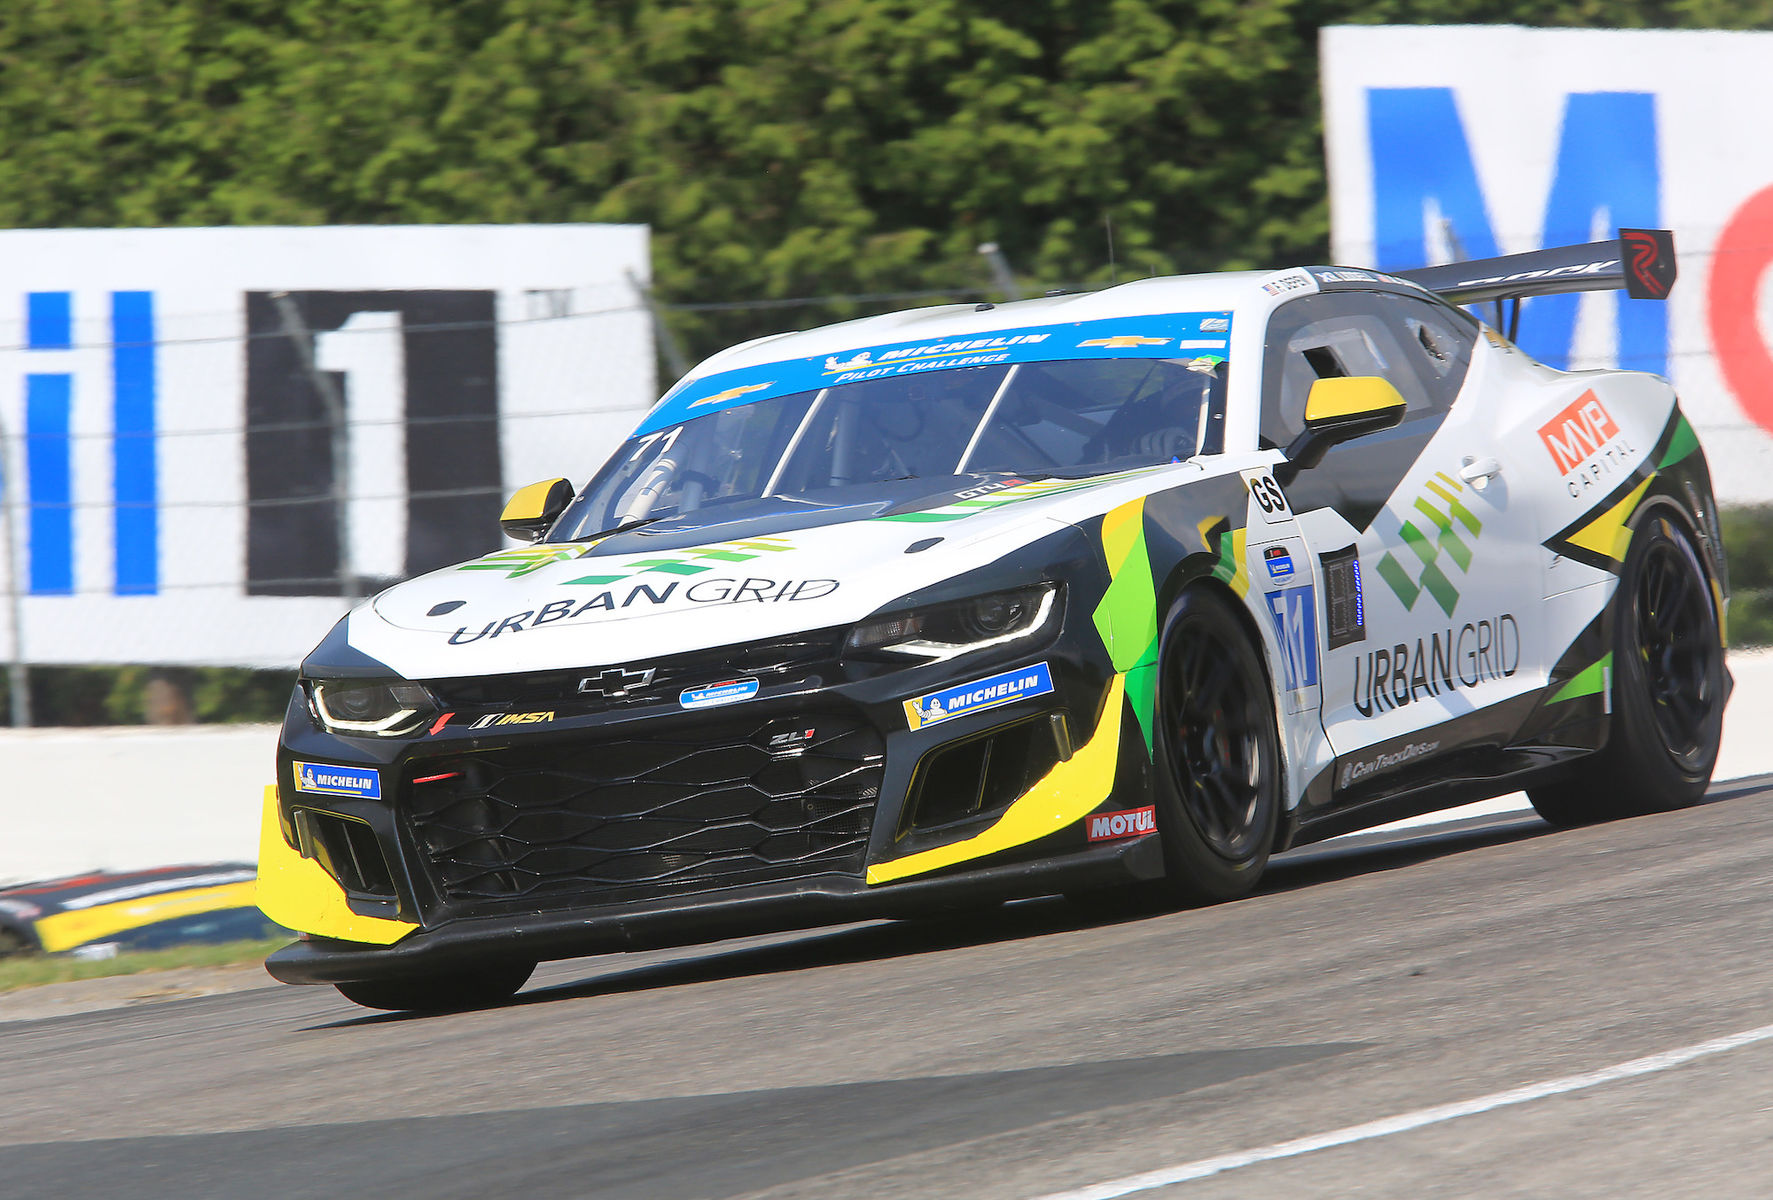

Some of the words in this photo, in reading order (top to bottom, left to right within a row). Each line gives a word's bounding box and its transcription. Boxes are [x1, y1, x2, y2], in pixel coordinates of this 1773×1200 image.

[877, 333, 1051, 361] MICHELIN
[833, 366, 896, 384] PILOT
[896, 353, 1012, 374] CHALLENGE
[629, 426, 684, 461] 71
[1547, 401, 1609, 475] MVP
[1567, 440, 1636, 498] CAPITAL
[1249, 476, 1285, 513] GS
[1272, 594, 1307, 685] 71
[949, 675, 1039, 710] MICHELIN
[495, 711, 555, 726] IMSA
[317, 774, 373, 790] MICHELIN
[1091, 809, 1155, 838] MOTUL
